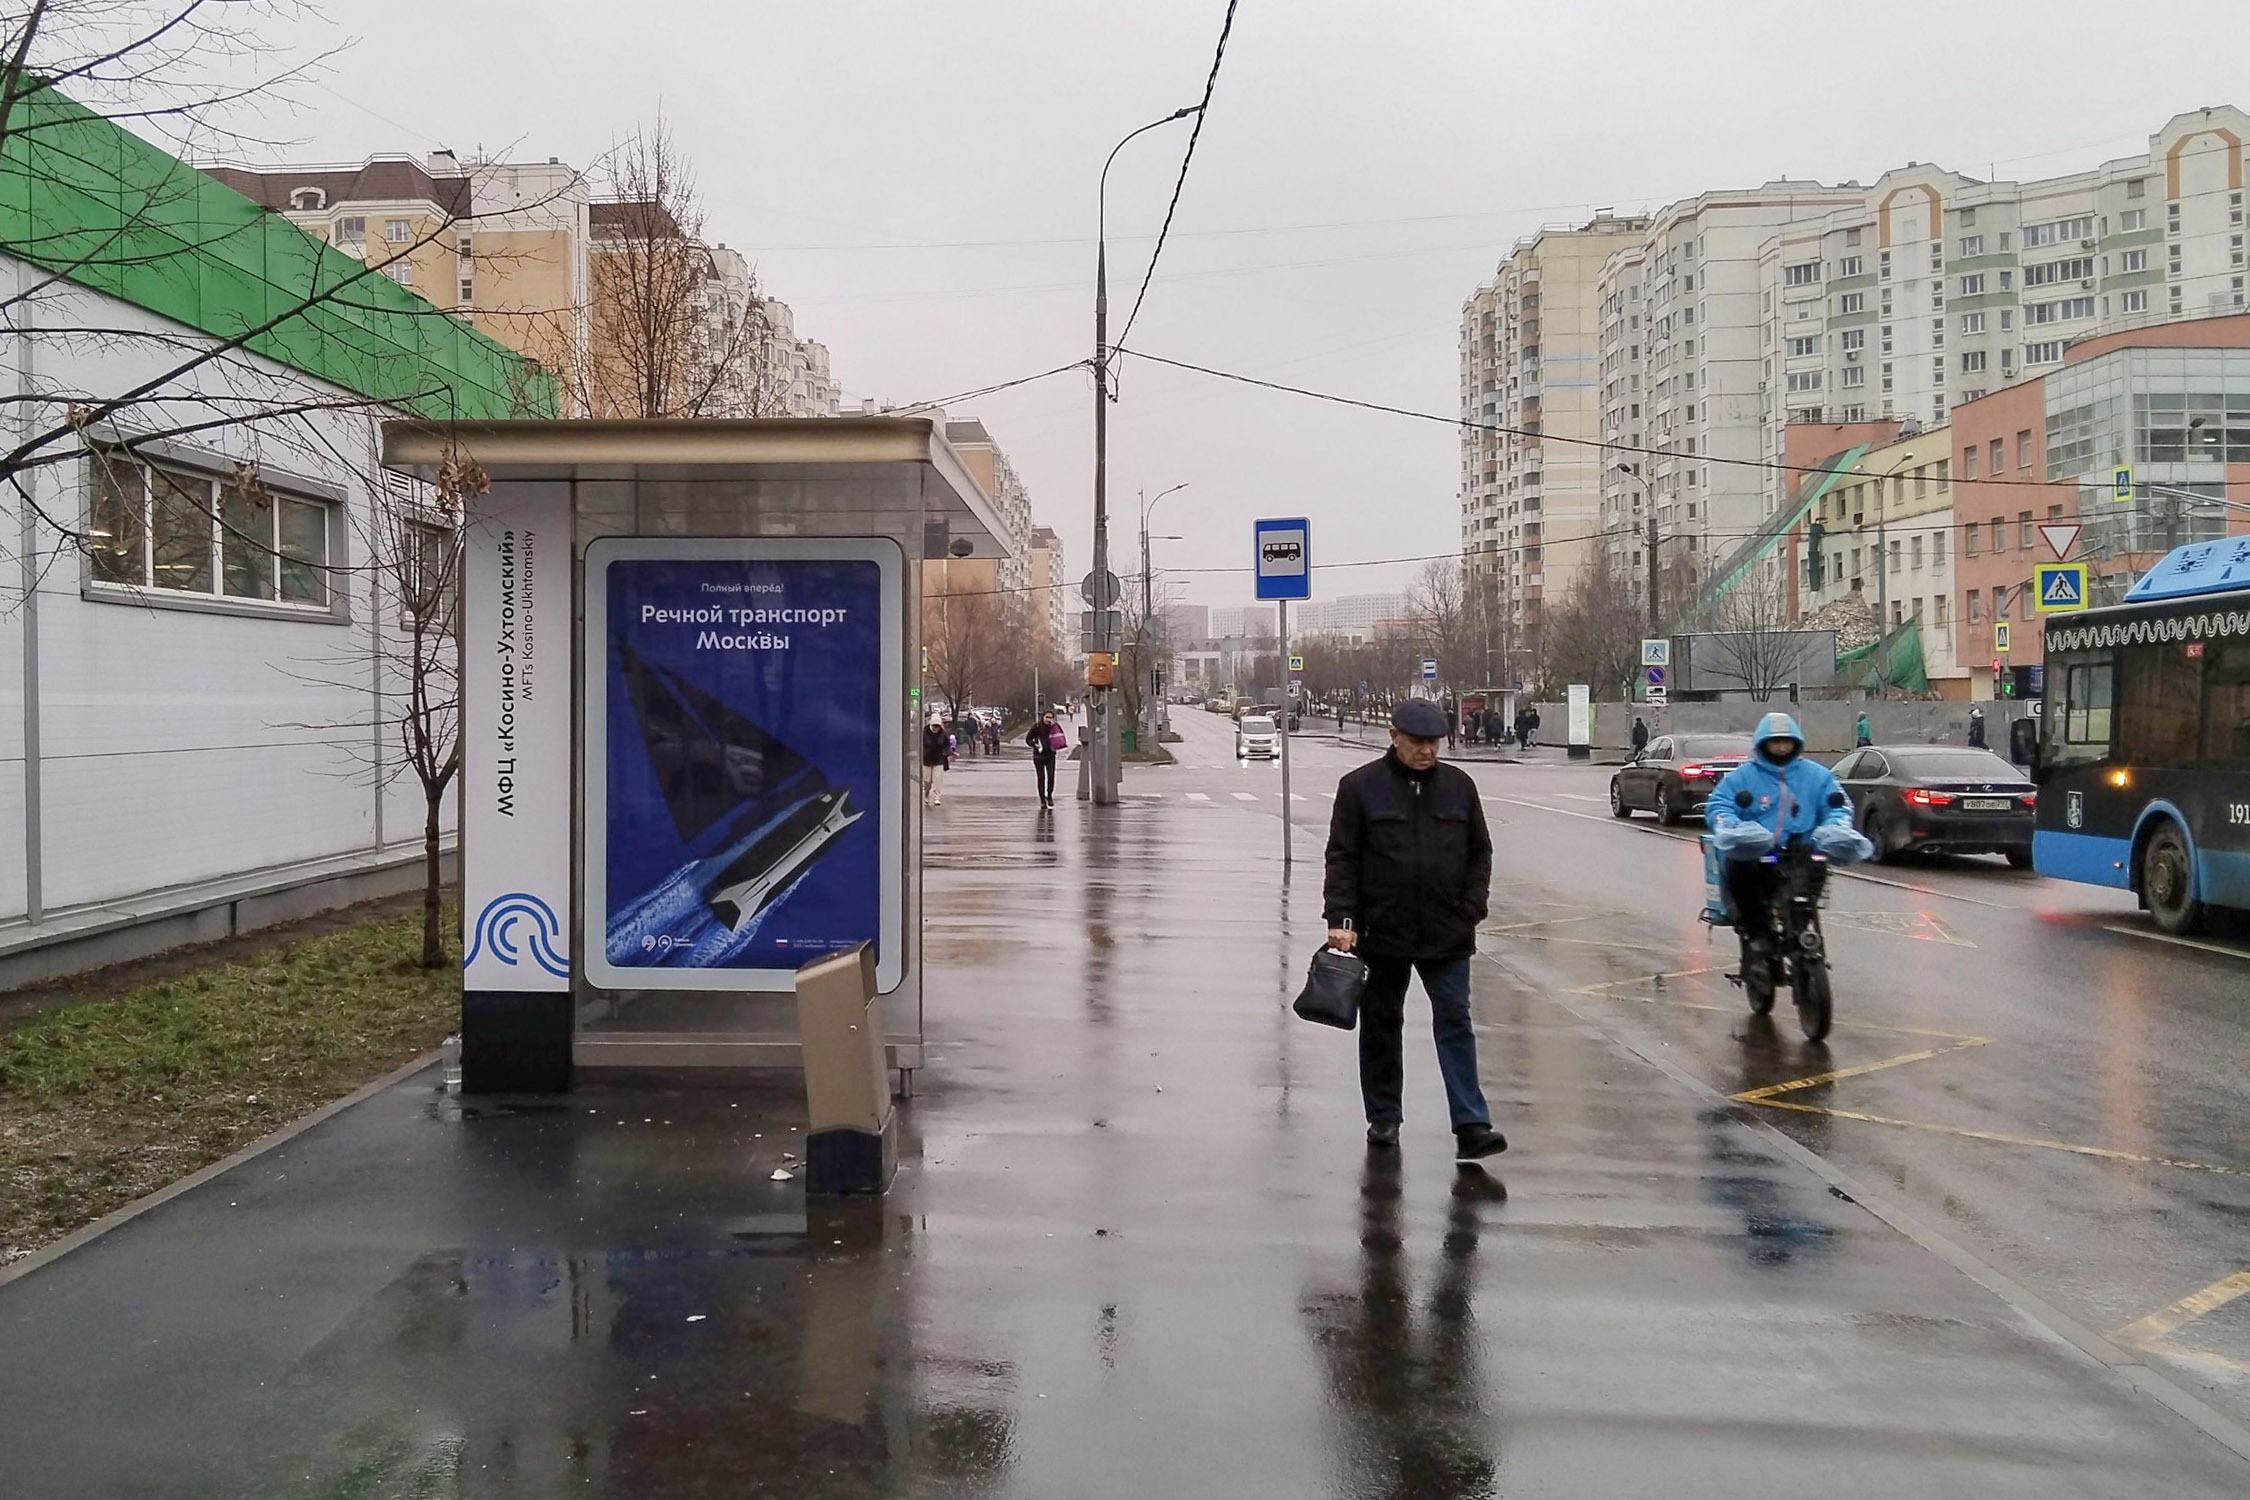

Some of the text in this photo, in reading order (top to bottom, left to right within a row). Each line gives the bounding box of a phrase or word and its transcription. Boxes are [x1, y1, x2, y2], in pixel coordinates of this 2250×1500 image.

[701, 583, 742, 593] Полный
[521, 530, 536, 701] MFTs Kosino-Ukhtomskiy
[642, 604, 847, 628] Речной транспорт
[696, 631, 790, 650] Москвы
[497, 530, 517, 817] МФЦ «Косино-Ухтомский»
